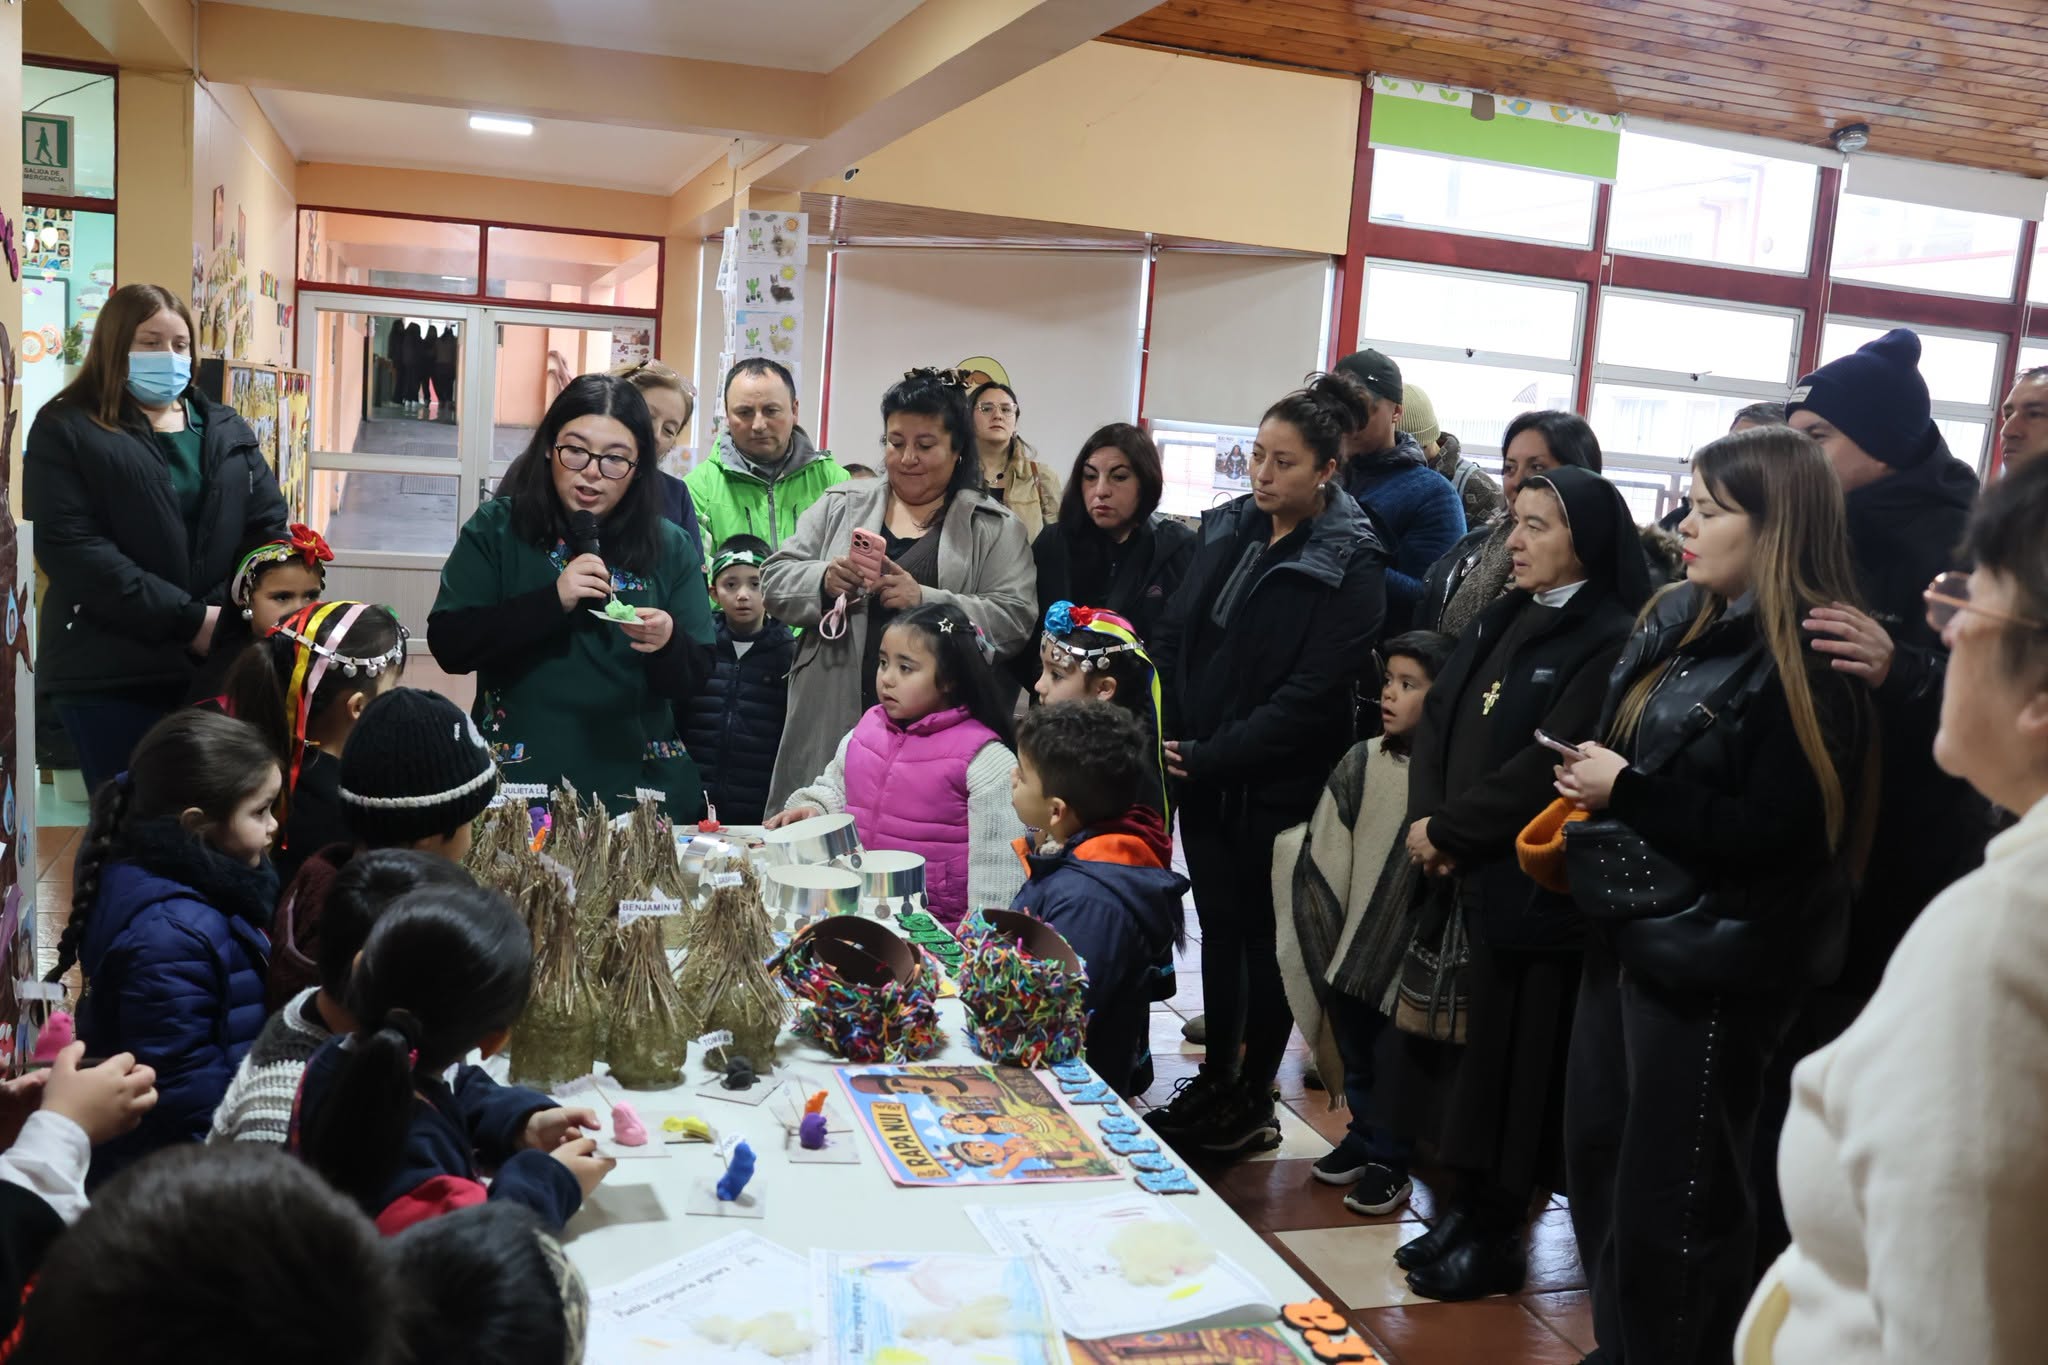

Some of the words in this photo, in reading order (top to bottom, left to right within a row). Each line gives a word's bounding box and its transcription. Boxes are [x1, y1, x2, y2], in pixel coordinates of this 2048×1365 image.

[24, 174, 64, 182] MERGENCIA
[503, 786, 535, 795] JULIETA
[622, 903, 671, 912] BENJAMIN
[672, 903, 679, 911] V
[878, 1113, 909, 1132] NUI
[888, 1134, 933, 1167] RAPA
